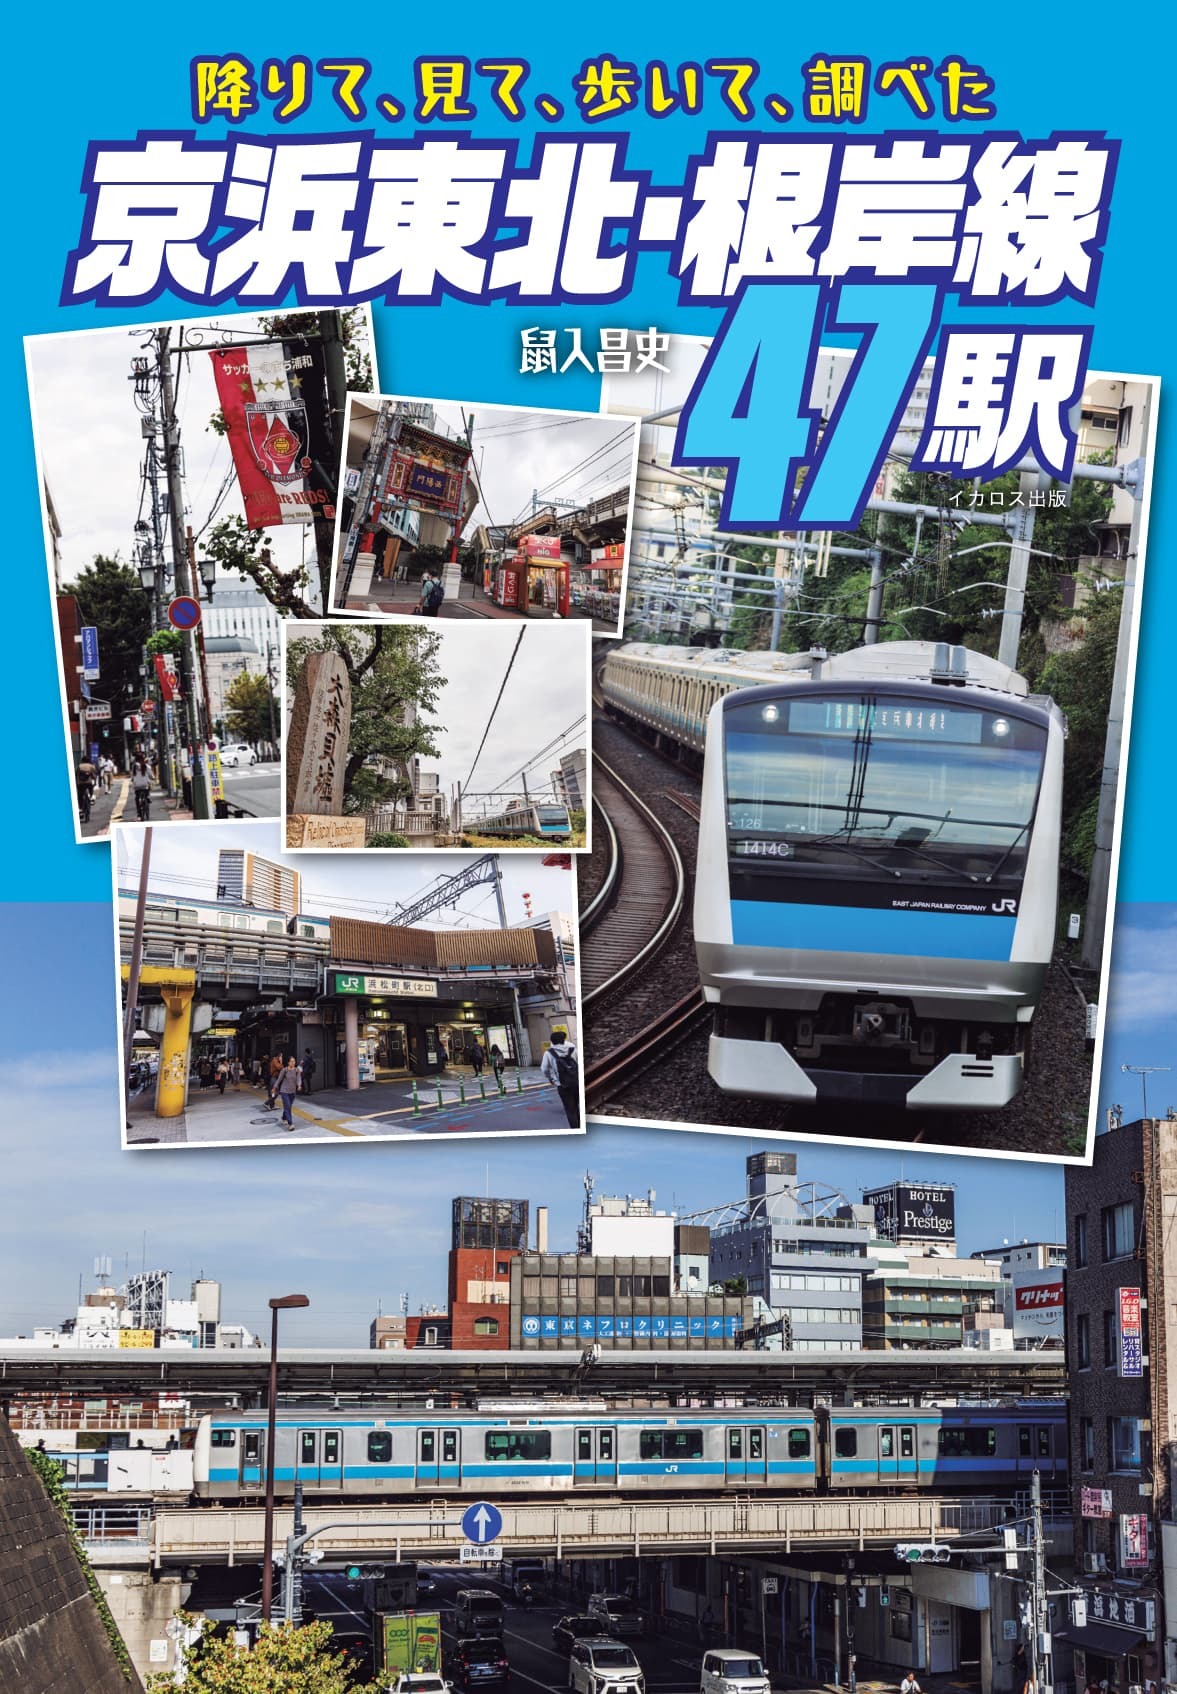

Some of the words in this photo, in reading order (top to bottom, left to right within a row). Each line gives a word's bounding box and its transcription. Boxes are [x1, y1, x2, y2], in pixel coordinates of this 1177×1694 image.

[743, 841, 790, 857] 1414C
[910, 901, 931, 909] JAPAN
[931, 902, 956, 910] RAILWAY
[956, 903, 987, 912] COMPANY
[991, 898, 1016, 913] JR
[341, 977, 359, 988] JR
[909, 1190, 946, 1202] HOTEL
[903, 1210, 953, 1233] Prestige
[545, 1319, 720, 1331] 東京ネフロクリニック
[664, 1464, 679, 1473] JR
